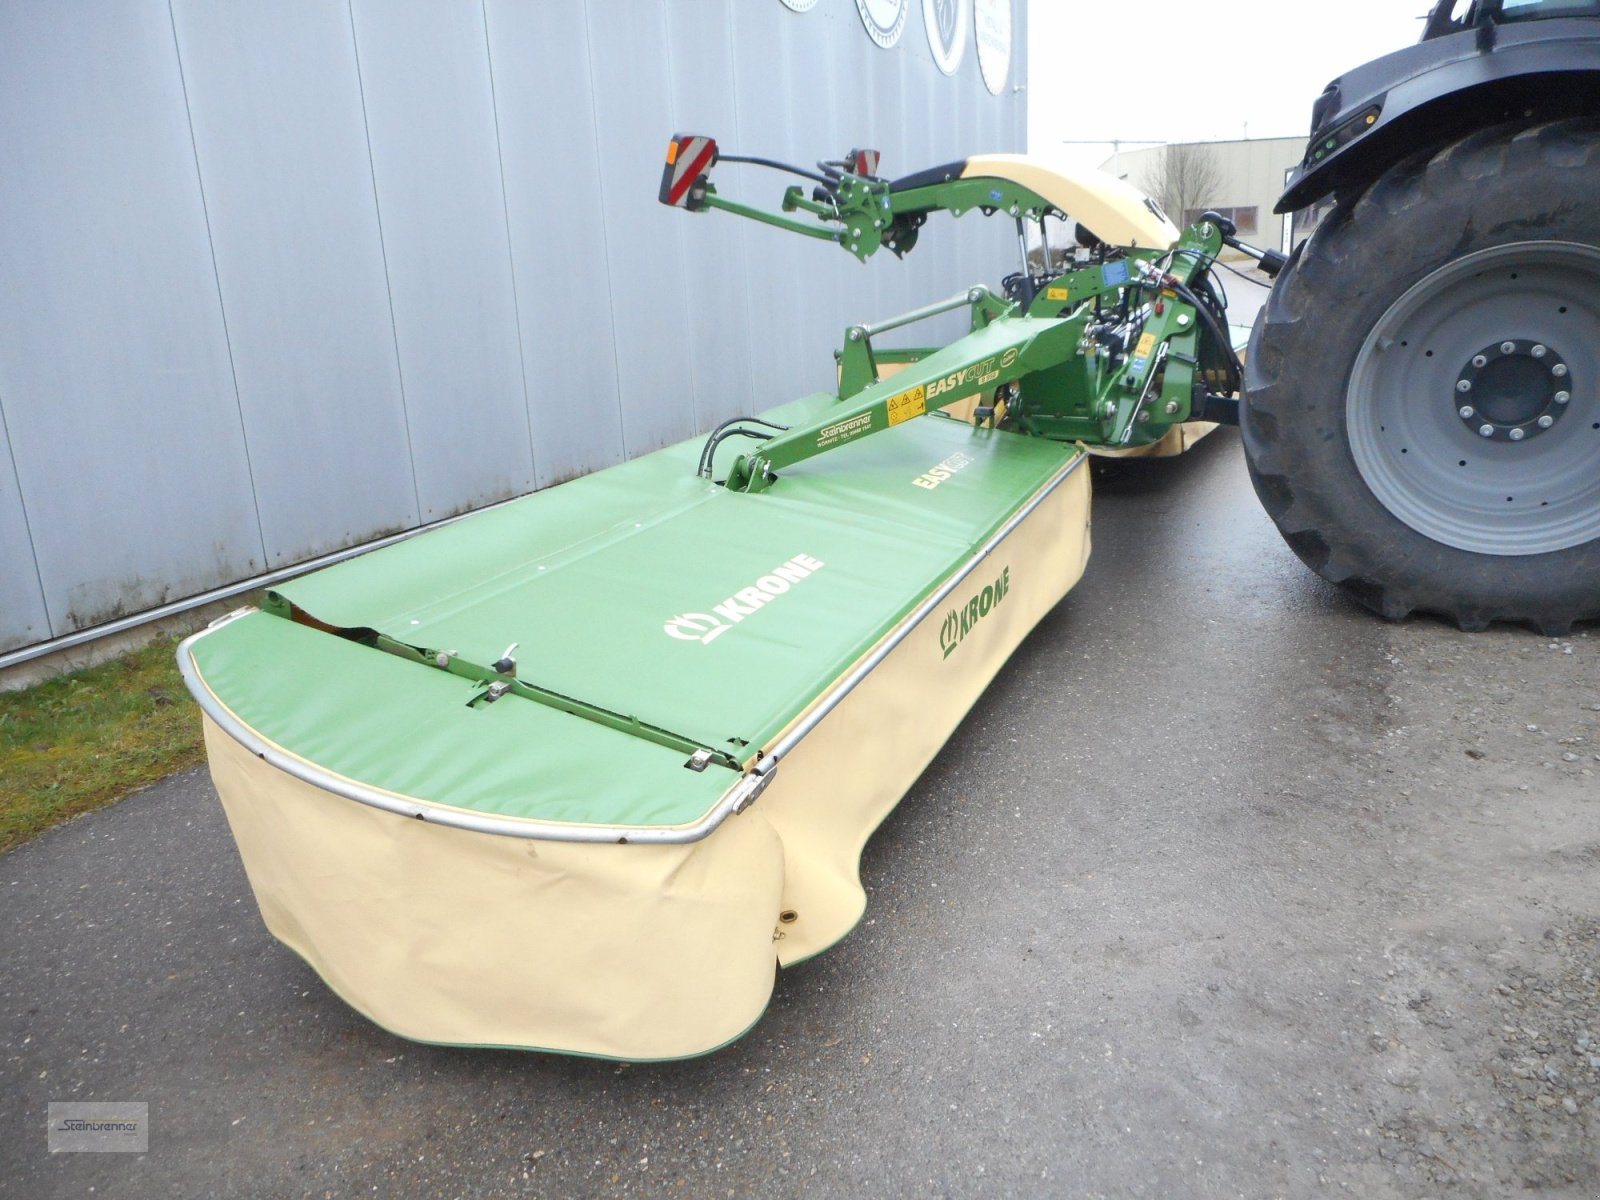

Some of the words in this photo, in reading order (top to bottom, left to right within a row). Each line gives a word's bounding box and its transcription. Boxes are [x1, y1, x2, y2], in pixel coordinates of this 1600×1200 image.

[926, 357, 996, 400] EASYCUT
[817, 411, 872, 441] Steinbrenner
[712, 552, 825, 623] KRONE
[959, 565, 1009, 642] KRONE
